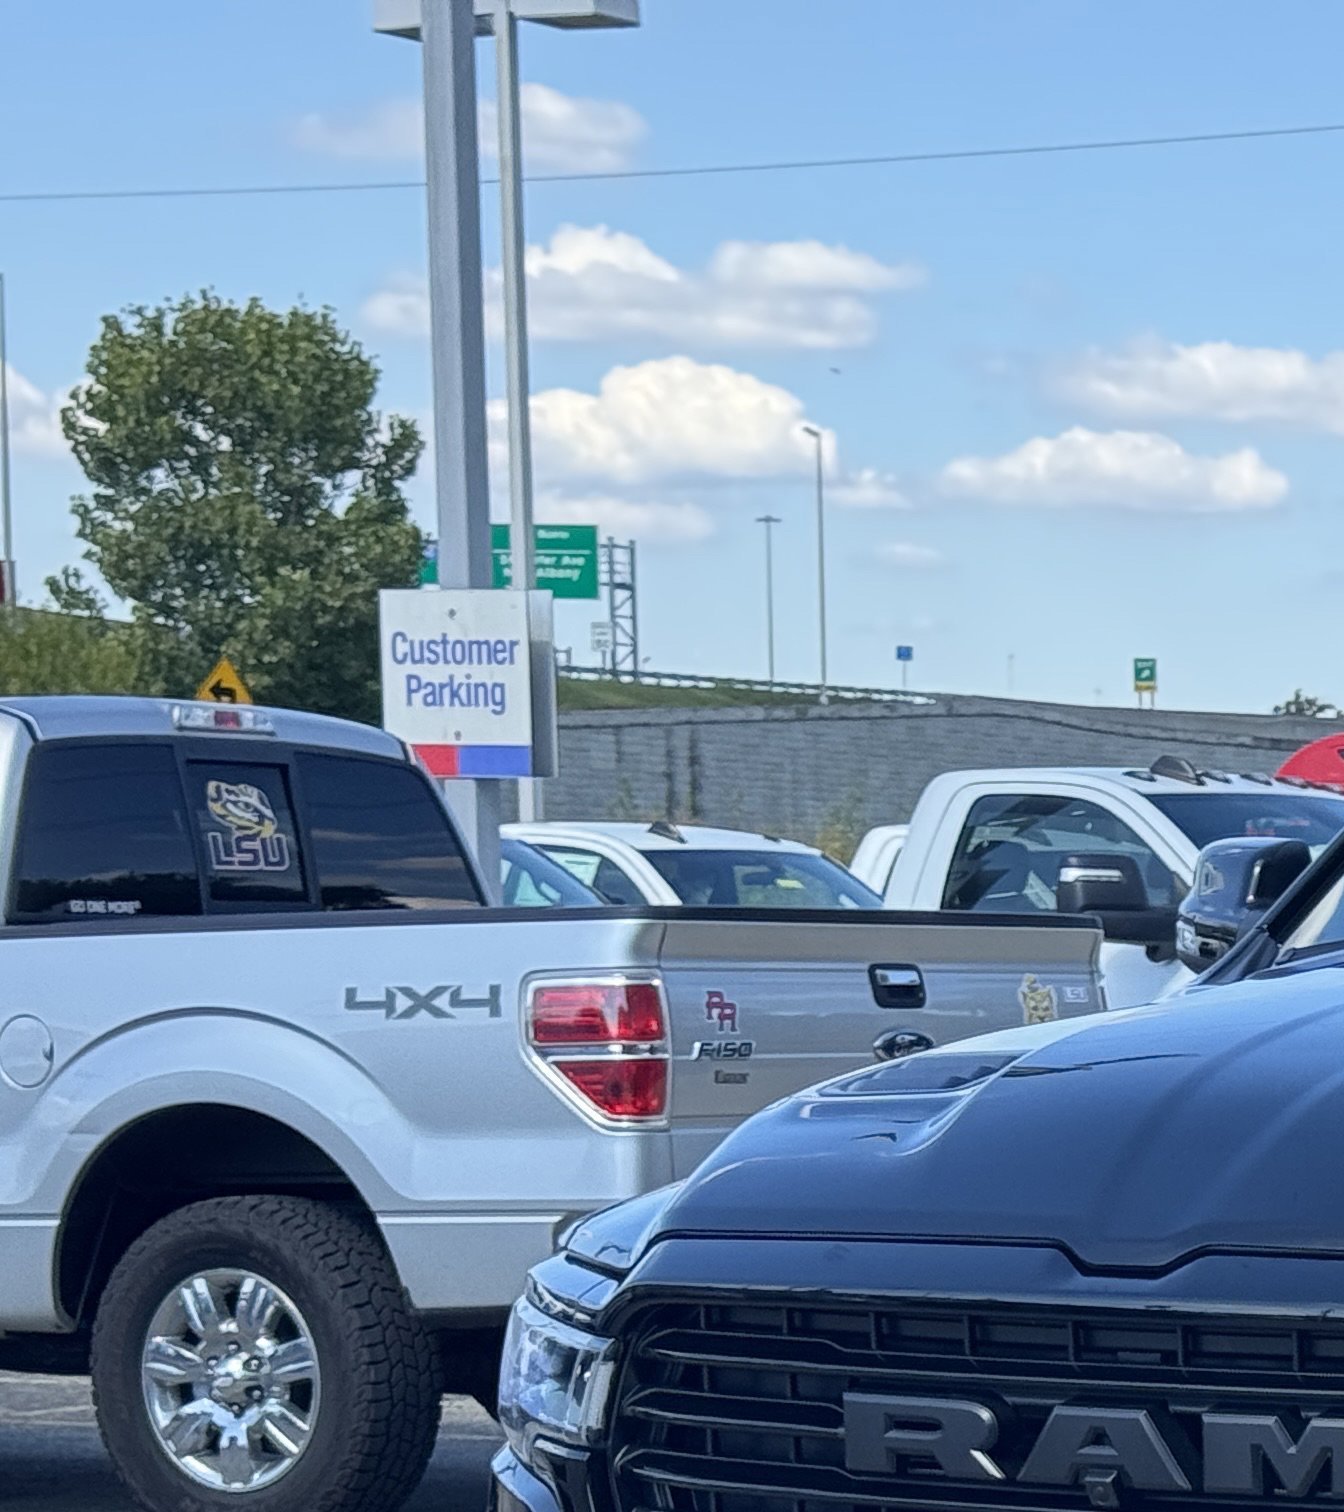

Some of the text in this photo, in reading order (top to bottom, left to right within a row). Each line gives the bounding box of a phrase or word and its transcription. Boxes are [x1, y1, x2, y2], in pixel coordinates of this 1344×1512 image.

[391, 631, 520, 665] Customer
[405, 673, 506, 716] Parking
[207, 830, 290, 872] LSU
[344, 984, 502, 1020] 4X4
